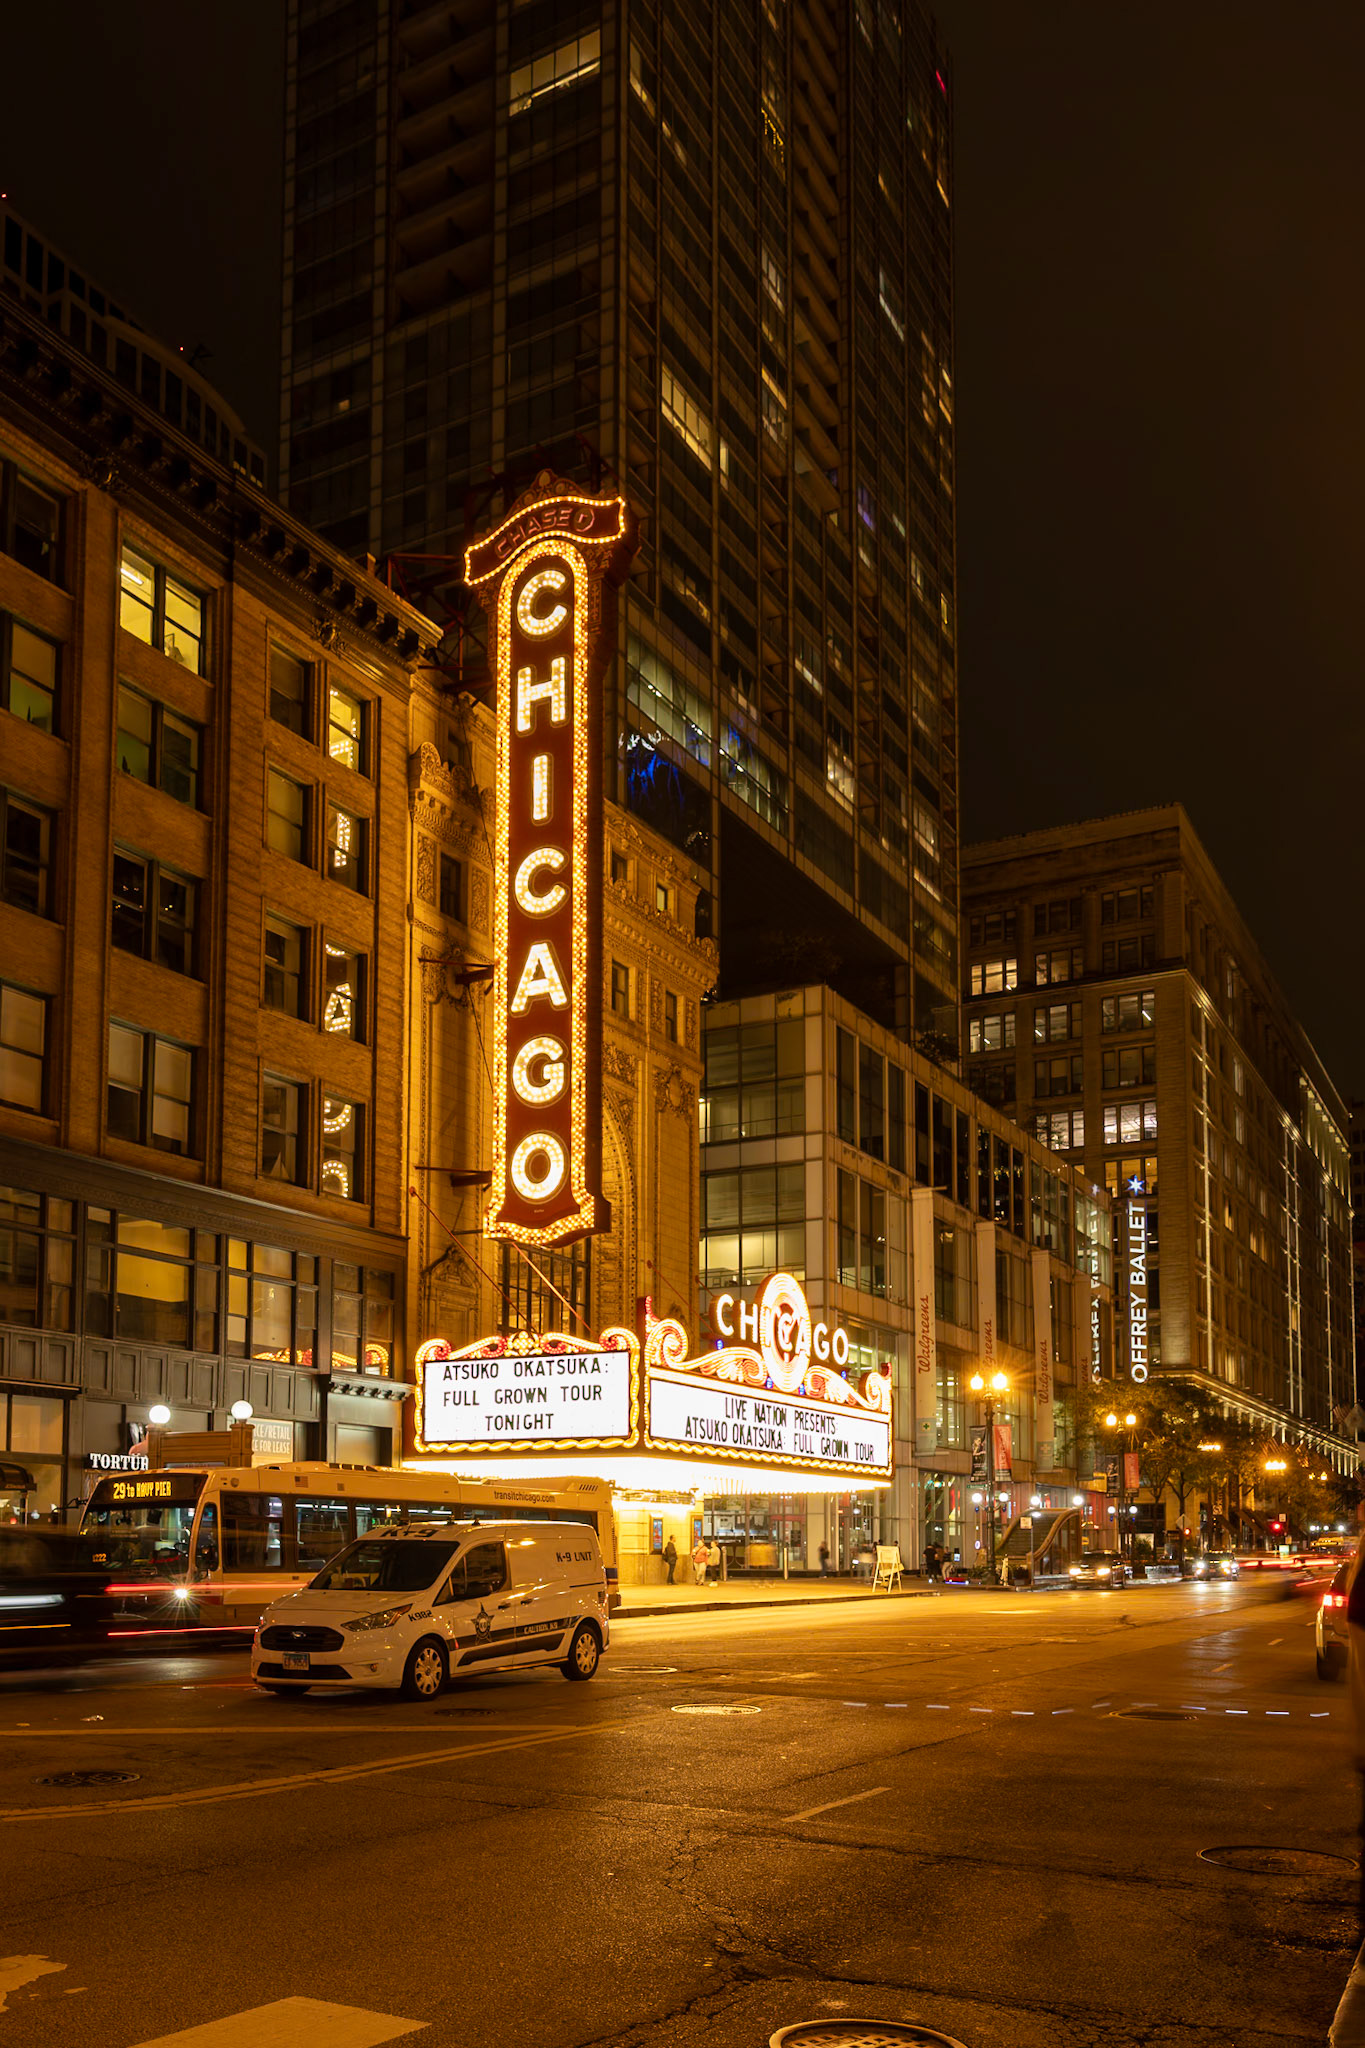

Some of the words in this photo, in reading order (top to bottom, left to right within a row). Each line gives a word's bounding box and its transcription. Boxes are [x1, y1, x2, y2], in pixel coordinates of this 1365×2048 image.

[495, 508, 573, 559] CHASE
[510, 568, 569, 1201] CHICAGO
[1128, 1202, 1146, 1286] BALLET
[716, 1293, 849, 1366] CHICAGO
[917, 1294, 934, 1374] Walgreens
[1130, 1292, 1148, 1384] OFFREY
[443, 1363, 499, 1381] ATSUKO
[514, 1357, 609, 1377] OKATSUKA:
[1038, 1339, 1052, 1406] Walgreens
[443, 1390, 480, 1407] FULL
[494, 1387, 547, 1405] GROWN
[560, 1384, 603, 1402] TOUR
[485, 1413, 554, 1431] TONIGHT
[725, 1396, 747, 1421] LIVE
[754, 1402, 787, 1428] NATION
[794, 1409, 838, 1435] PRESENTS:
[259, 1440, 272, 1453] FOR
[272, 1441, 291, 1455] LEASE
[684, 1415, 728, 1443] ATSUKO
[732, 1423, 786, 1451] OKATSUKA:
[793, 1432, 815, 1455] FULL
[820, 1437, 849, 1459] GROWN
[854, 1442, 875, 1463] TOUR
[90, 1453, 149, 1471] TORTUR
[113, 1482, 126, 1500] 29
[126, 1483, 135, 1498] to
[154, 1481, 172, 1497] PIER
[494, 1490, 556, 1504] transitchicago.com
[574, 1551, 592, 1562] UNIT
[408, 1609, 433, 1622] K982
